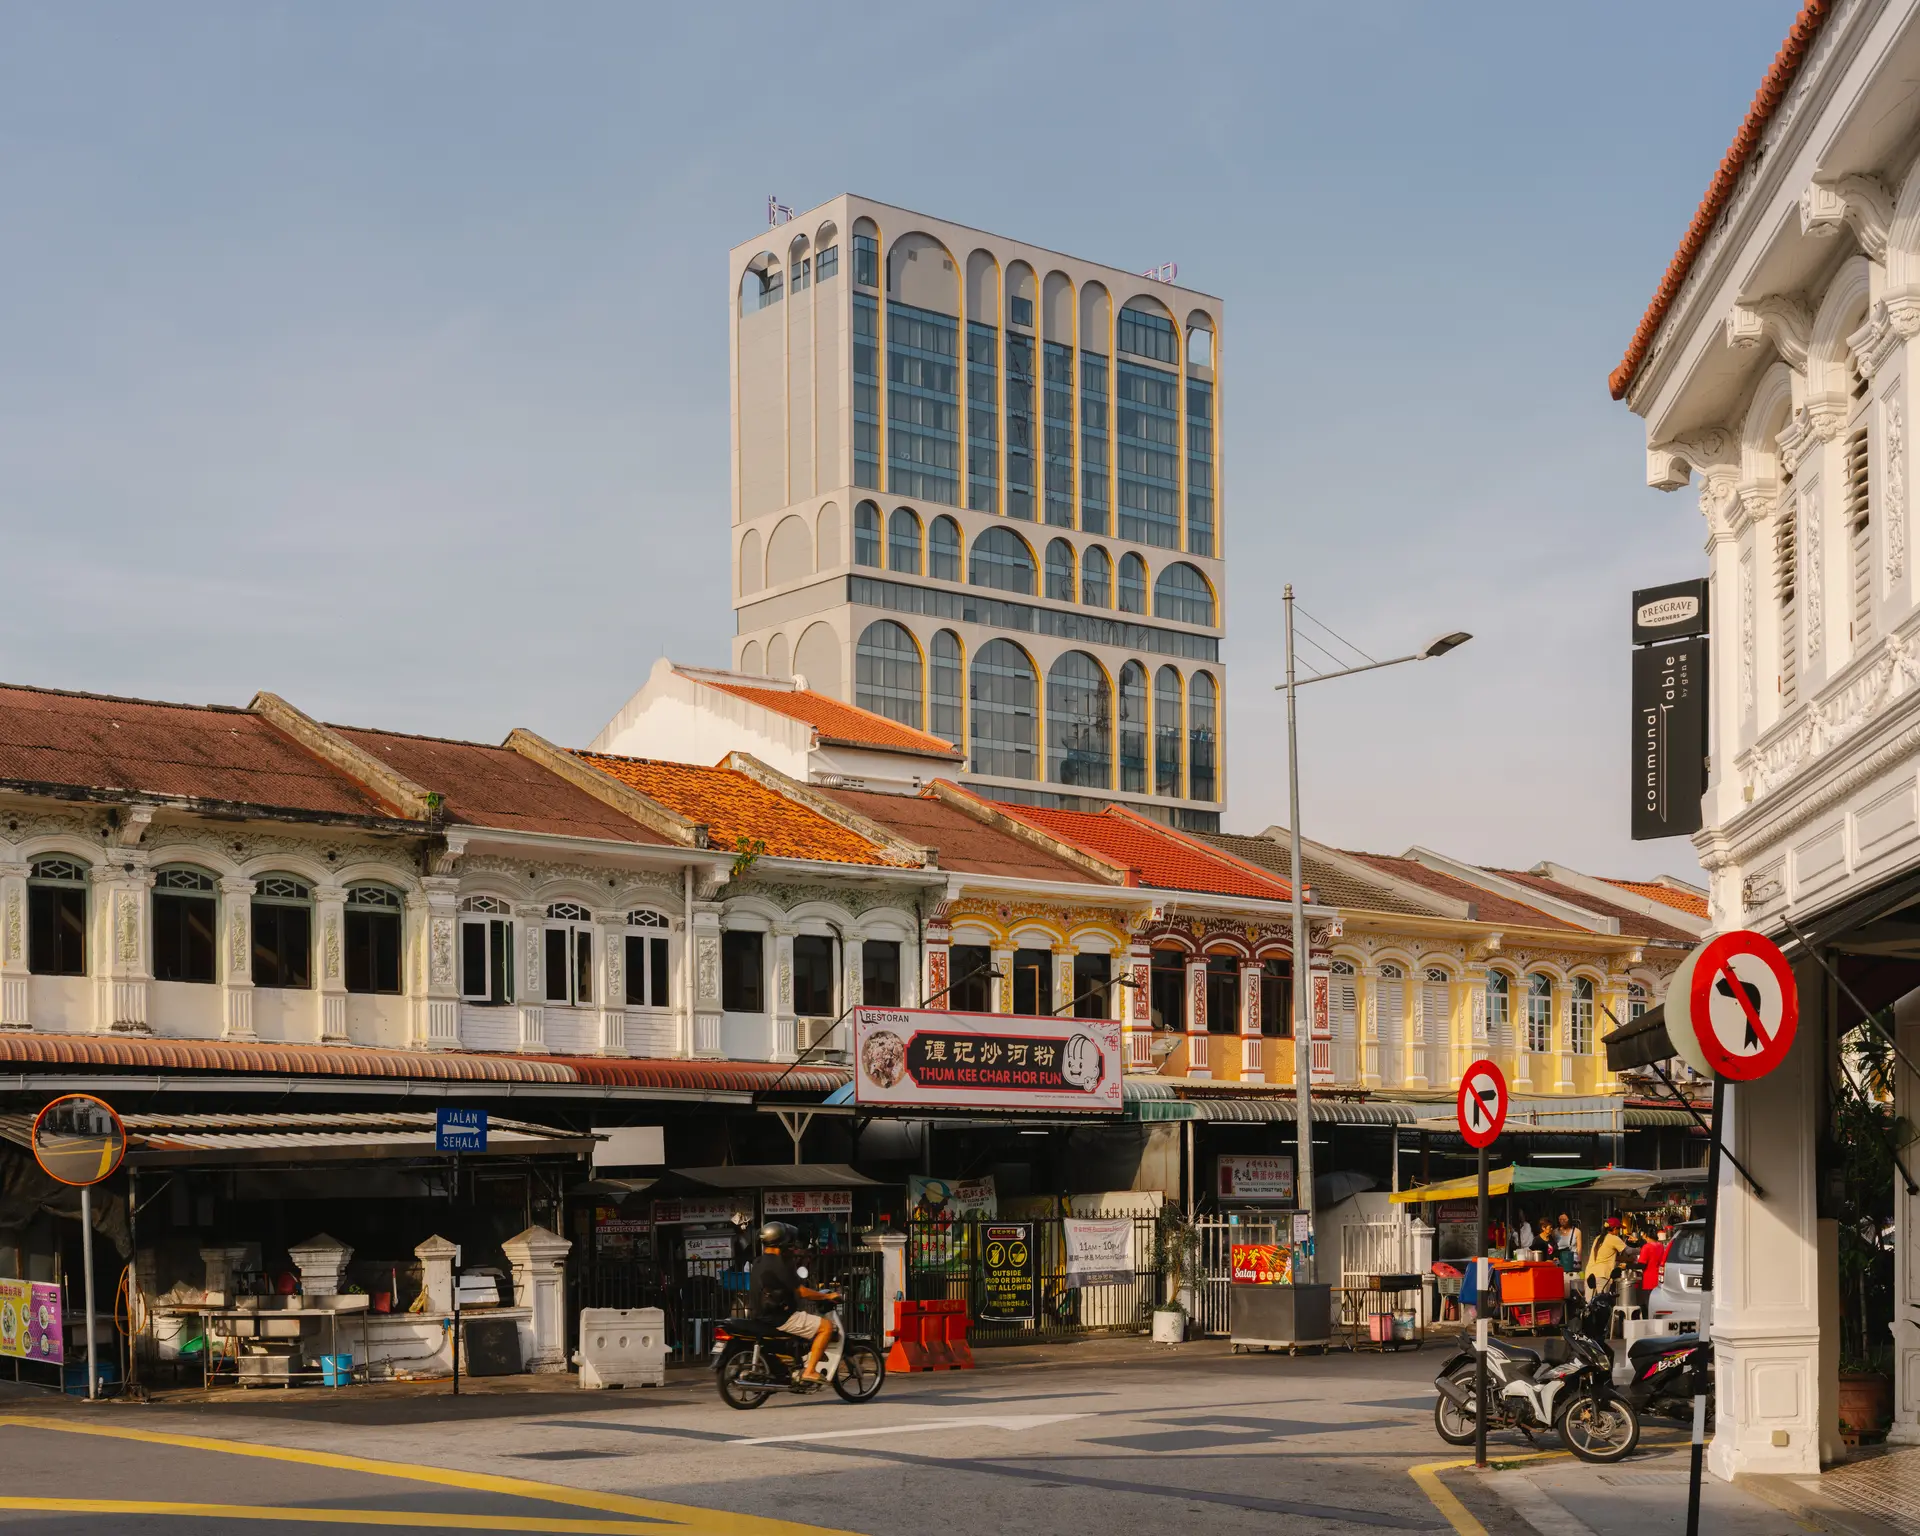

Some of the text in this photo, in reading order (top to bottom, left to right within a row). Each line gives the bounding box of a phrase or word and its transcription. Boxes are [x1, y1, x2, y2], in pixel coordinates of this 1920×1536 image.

[1642, 600, 1692, 619] PRESGRAVE
[1653, 613, 1681, 623] CORNERS
[1643, 706, 1657, 812] communal
[865, 1012, 909, 1023] RESTORAN
[924, 1039, 1056, 1067] 谭记炒河粉
[919, 1066, 1062, 1085] THUM KEE CHAR HOR FUN
[447, 1112, 478, 1123] JALAN
[443, 1136, 480, 1148] SEHALA
[1079, 1242, 1097, 1251] 11AM
[992, 1269, 1022, 1277] OUTSIDE
[1234, 1267, 1257, 1281] Satay
[1011, 1276, 1032, 1284] DRINK
[998, 1283, 1032, 1291] ALLOWED
[1668, 1322, 1679, 1331] NO
